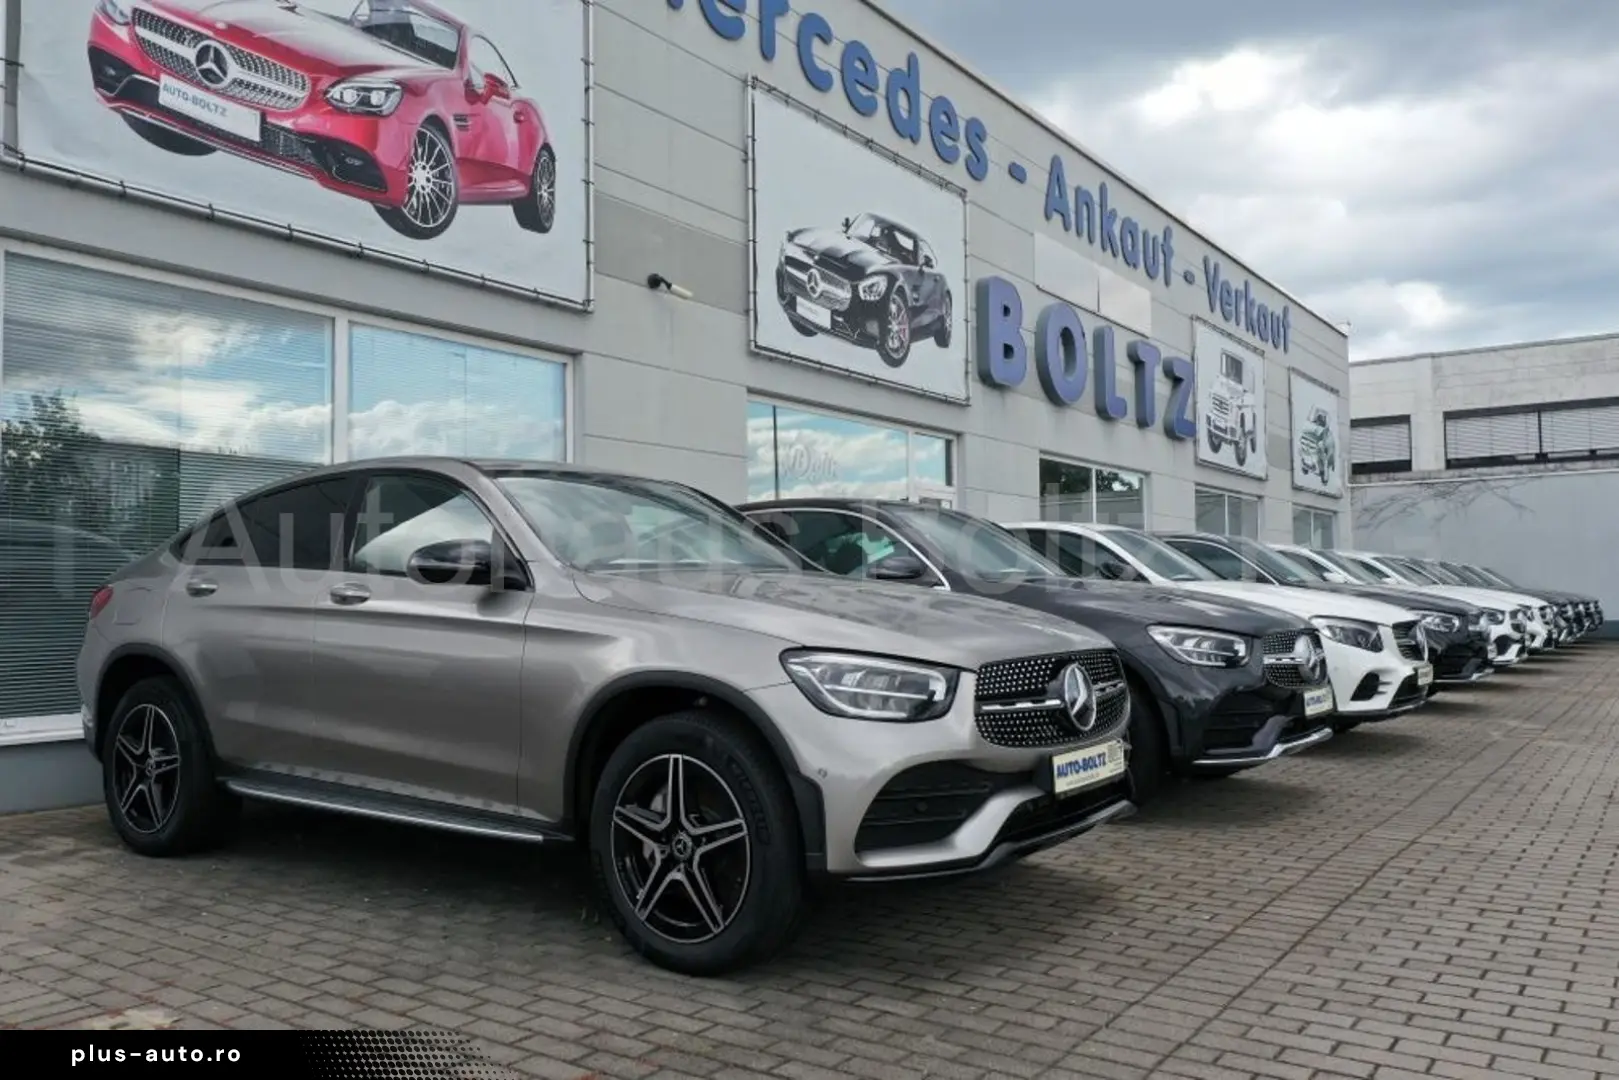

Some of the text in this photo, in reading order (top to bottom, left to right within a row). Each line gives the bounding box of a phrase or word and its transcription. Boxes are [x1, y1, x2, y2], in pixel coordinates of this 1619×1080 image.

[162, 82, 229, 118] AUTO-BOLTZ
[664, 0, 989, 182] ercedes
[1044, 153, 1175, 287] Ankauf
[1203, 254, 1290, 353] Verkauf
[975, 275, 1196, 440] BOLTZ
[1056, 751, 1107, 778] AUTO-BOLTZ
